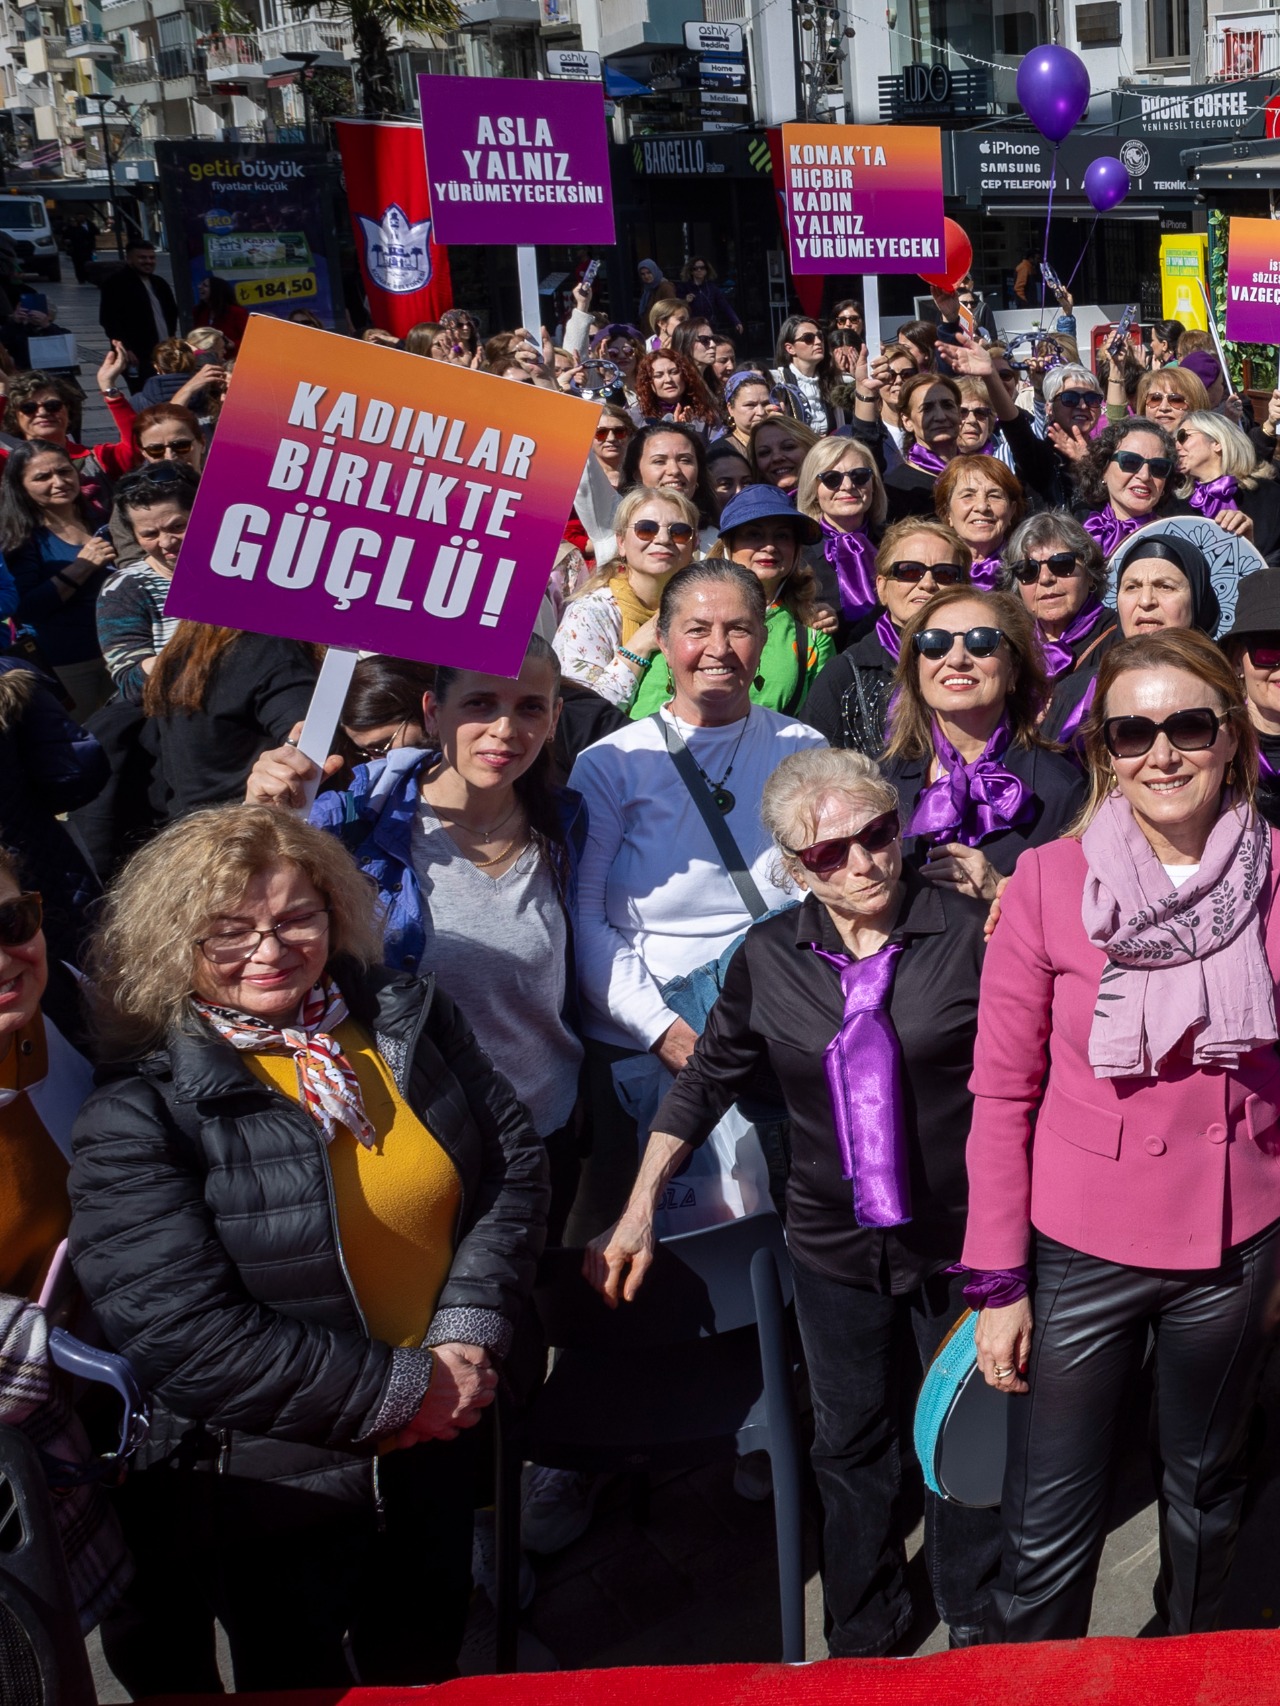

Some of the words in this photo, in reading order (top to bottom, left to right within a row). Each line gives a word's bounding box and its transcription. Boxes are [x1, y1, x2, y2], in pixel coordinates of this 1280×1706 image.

[701, 42, 729, 50] Bedding
[709, 95, 739, 103] Medical
[1141, 95, 1190, 121] PHONE
[1194, 91, 1248, 118] COFFEE
[477, 115, 553, 147] ASLA
[1142, 121, 1161, 131] YENİ
[1163, 119, 1188, 131] NESİL
[1189, 118, 1248, 130] TELEFONCU
[643, 140, 704, 174] BARGELLO
[789, 145, 887, 166] KONAK'TA
[992, 141, 1040, 155] iPhone
[462, 150, 572, 181] YALNIZ
[980, 163, 1041, 173] SAMSUNG
[211, 181, 252, 193] fiyatlar
[254, 182, 288, 192] küçük
[434, 180, 603, 204] YÜRÜMEYECEKSİN!
[981, 180, 1001, 189] CEP
[1004, 180, 1056, 189] TELEFONU
[1154, 179, 1186, 190] TEKNİK
[792, 192, 852, 212] KADIN
[794, 215, 864, 235] YALNIZ
[1166, 220, 1187, 229] iPhone
[796, 235, 940, 259] YÜRÜMEYECEK!
[254, 278, 313, 298] 184,50
[288, 381, 536, 480] KADINLAR
[268, 432, 522, 539] BİRLİKTE
[209, 502, 517, 628] GÜÇLÜ!
